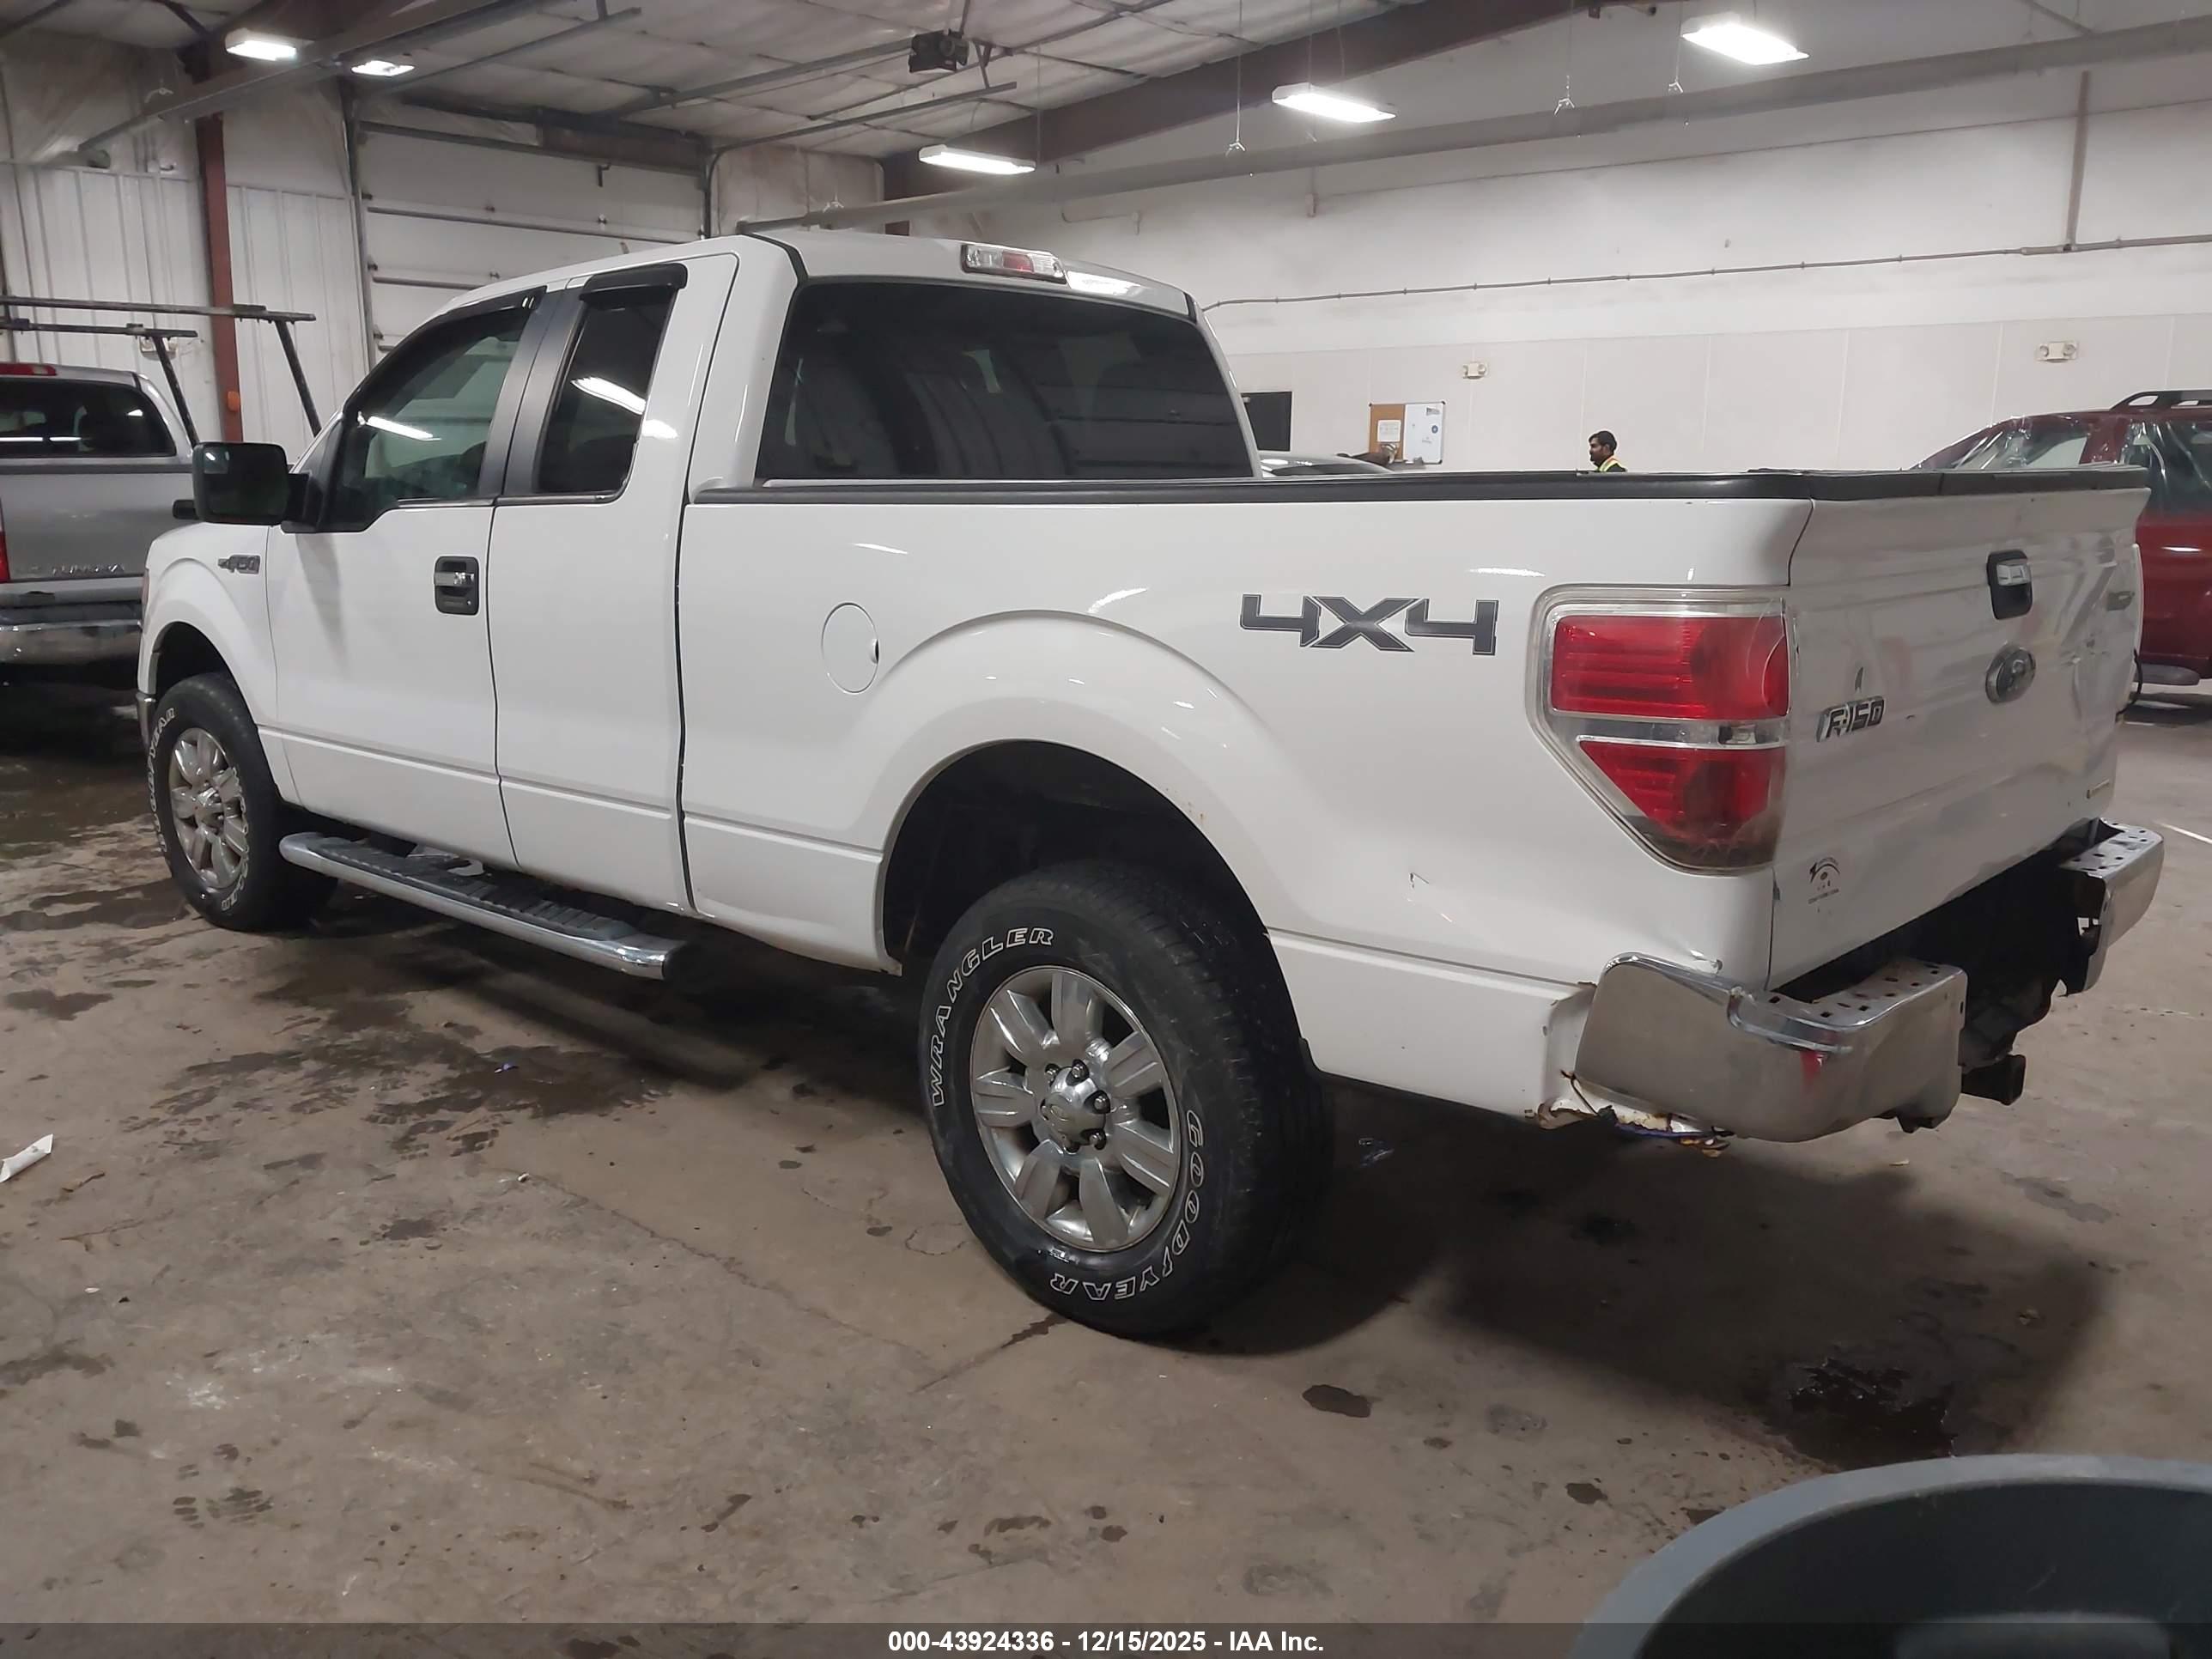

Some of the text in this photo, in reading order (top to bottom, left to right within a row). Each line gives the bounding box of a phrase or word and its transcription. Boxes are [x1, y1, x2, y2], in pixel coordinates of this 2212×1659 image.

[1240, 594, 1499, 656] 4X4
[1822, 696, 1886, 740] F-150
[931, 927, 1054, 1107] WRANGLER
[1050, 1109, 1205, 1302] GOODYEAR
